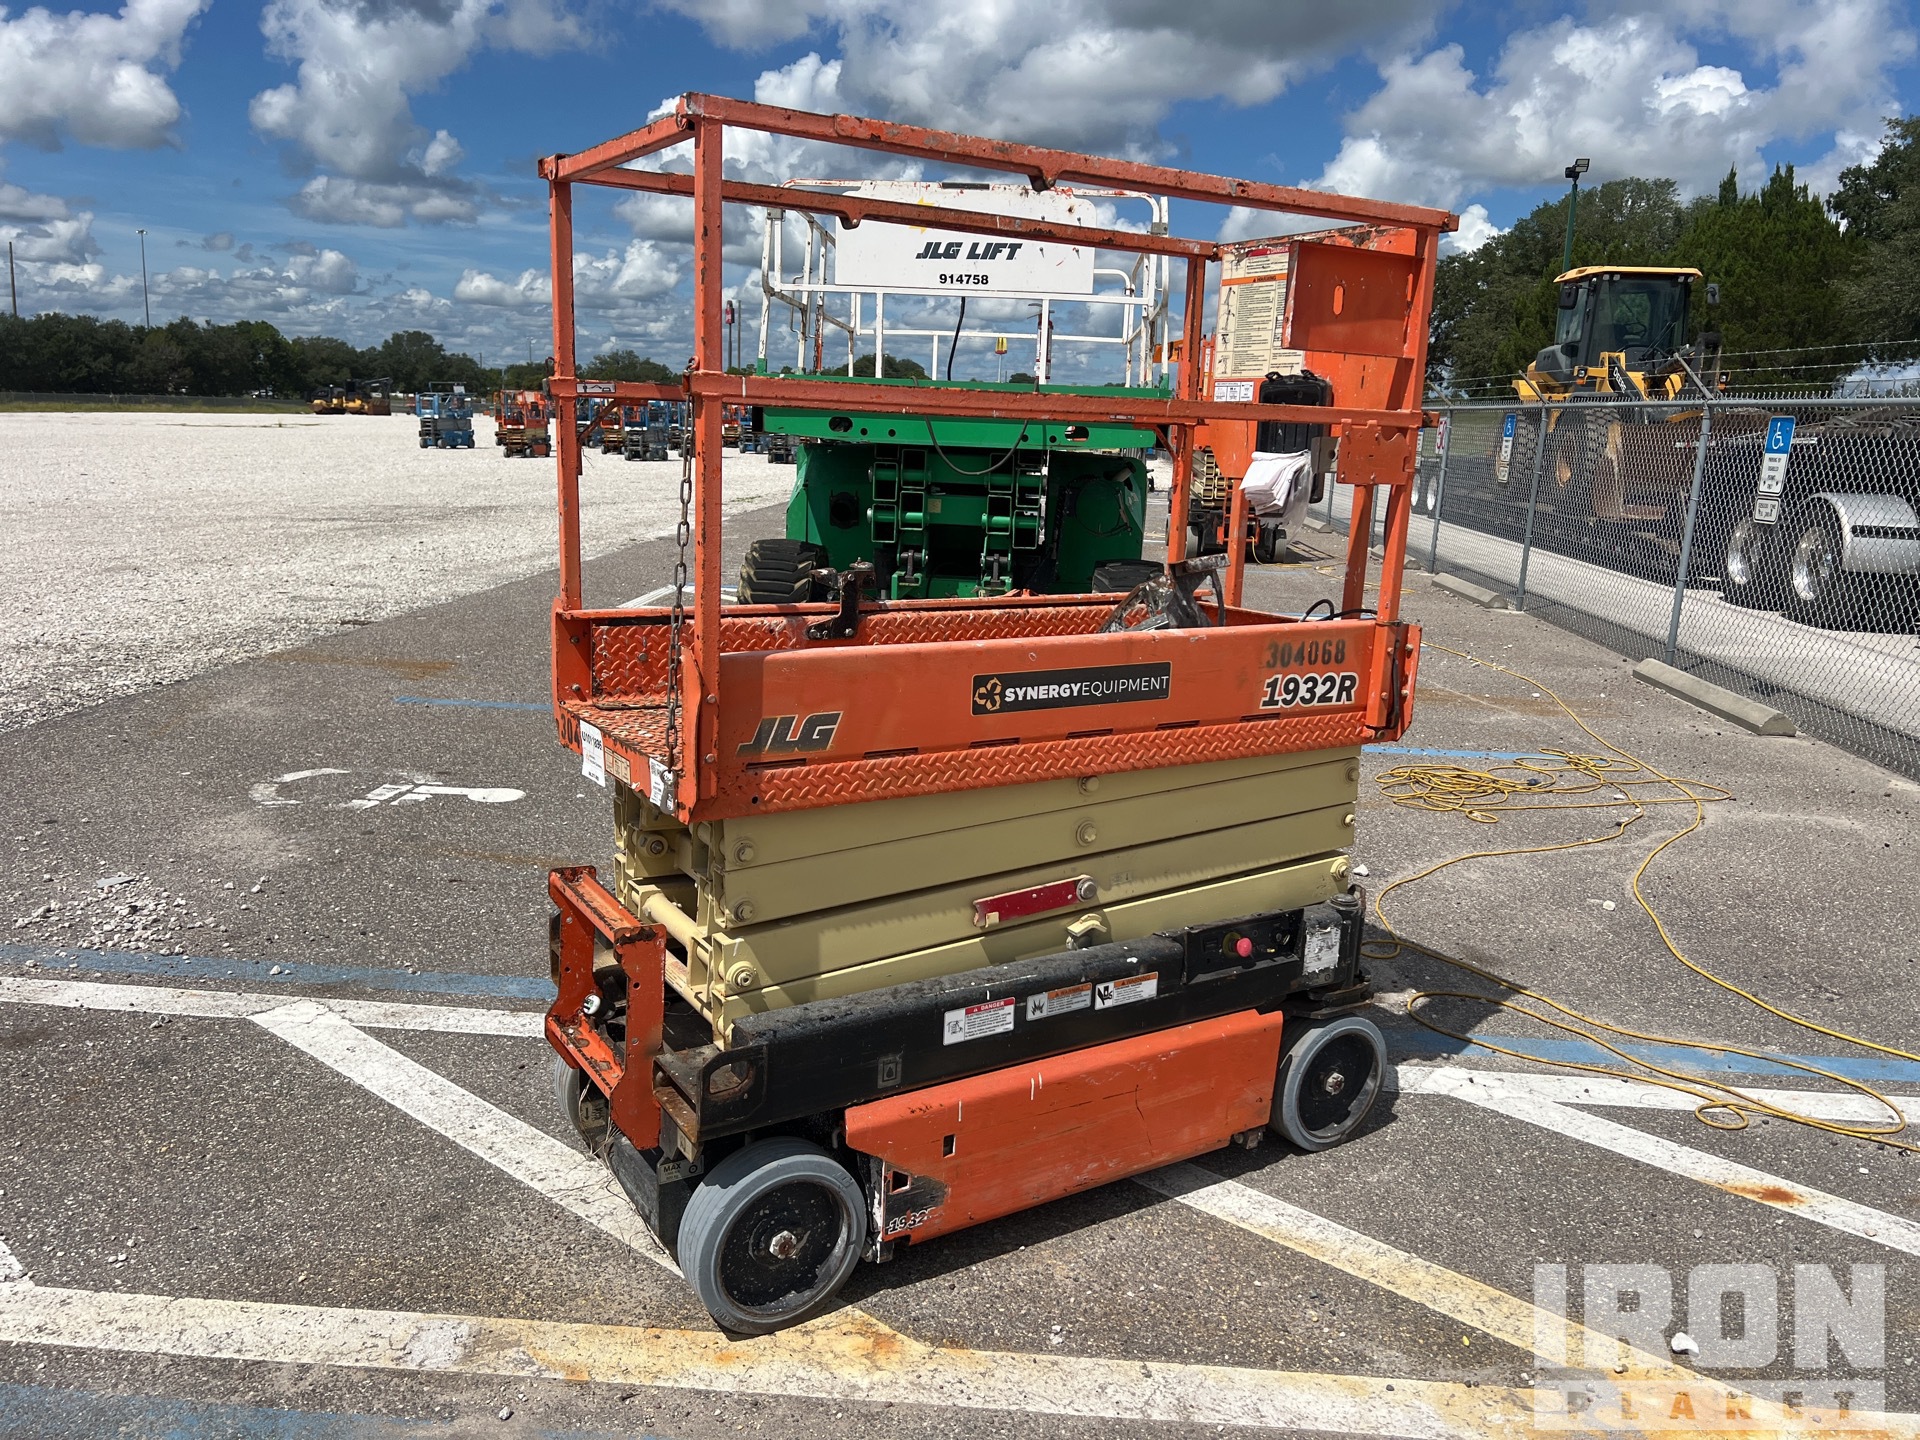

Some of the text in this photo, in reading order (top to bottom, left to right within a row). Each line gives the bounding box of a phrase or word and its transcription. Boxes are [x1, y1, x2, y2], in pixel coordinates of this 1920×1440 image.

[915, 241, 1023, 260] JLG LIFT
[939, 273, 989, 285] 914758
[1613, 366, 1627, 394] DEERE
[1266, 639, 1346, 668] 304068
[1259, 672, 1359, 709] 1932R
[734, 711, 844, 757] JLG
[980, 1001, 1005, 1011] DANGER
[663, 1163, 682, 1173] MAX
